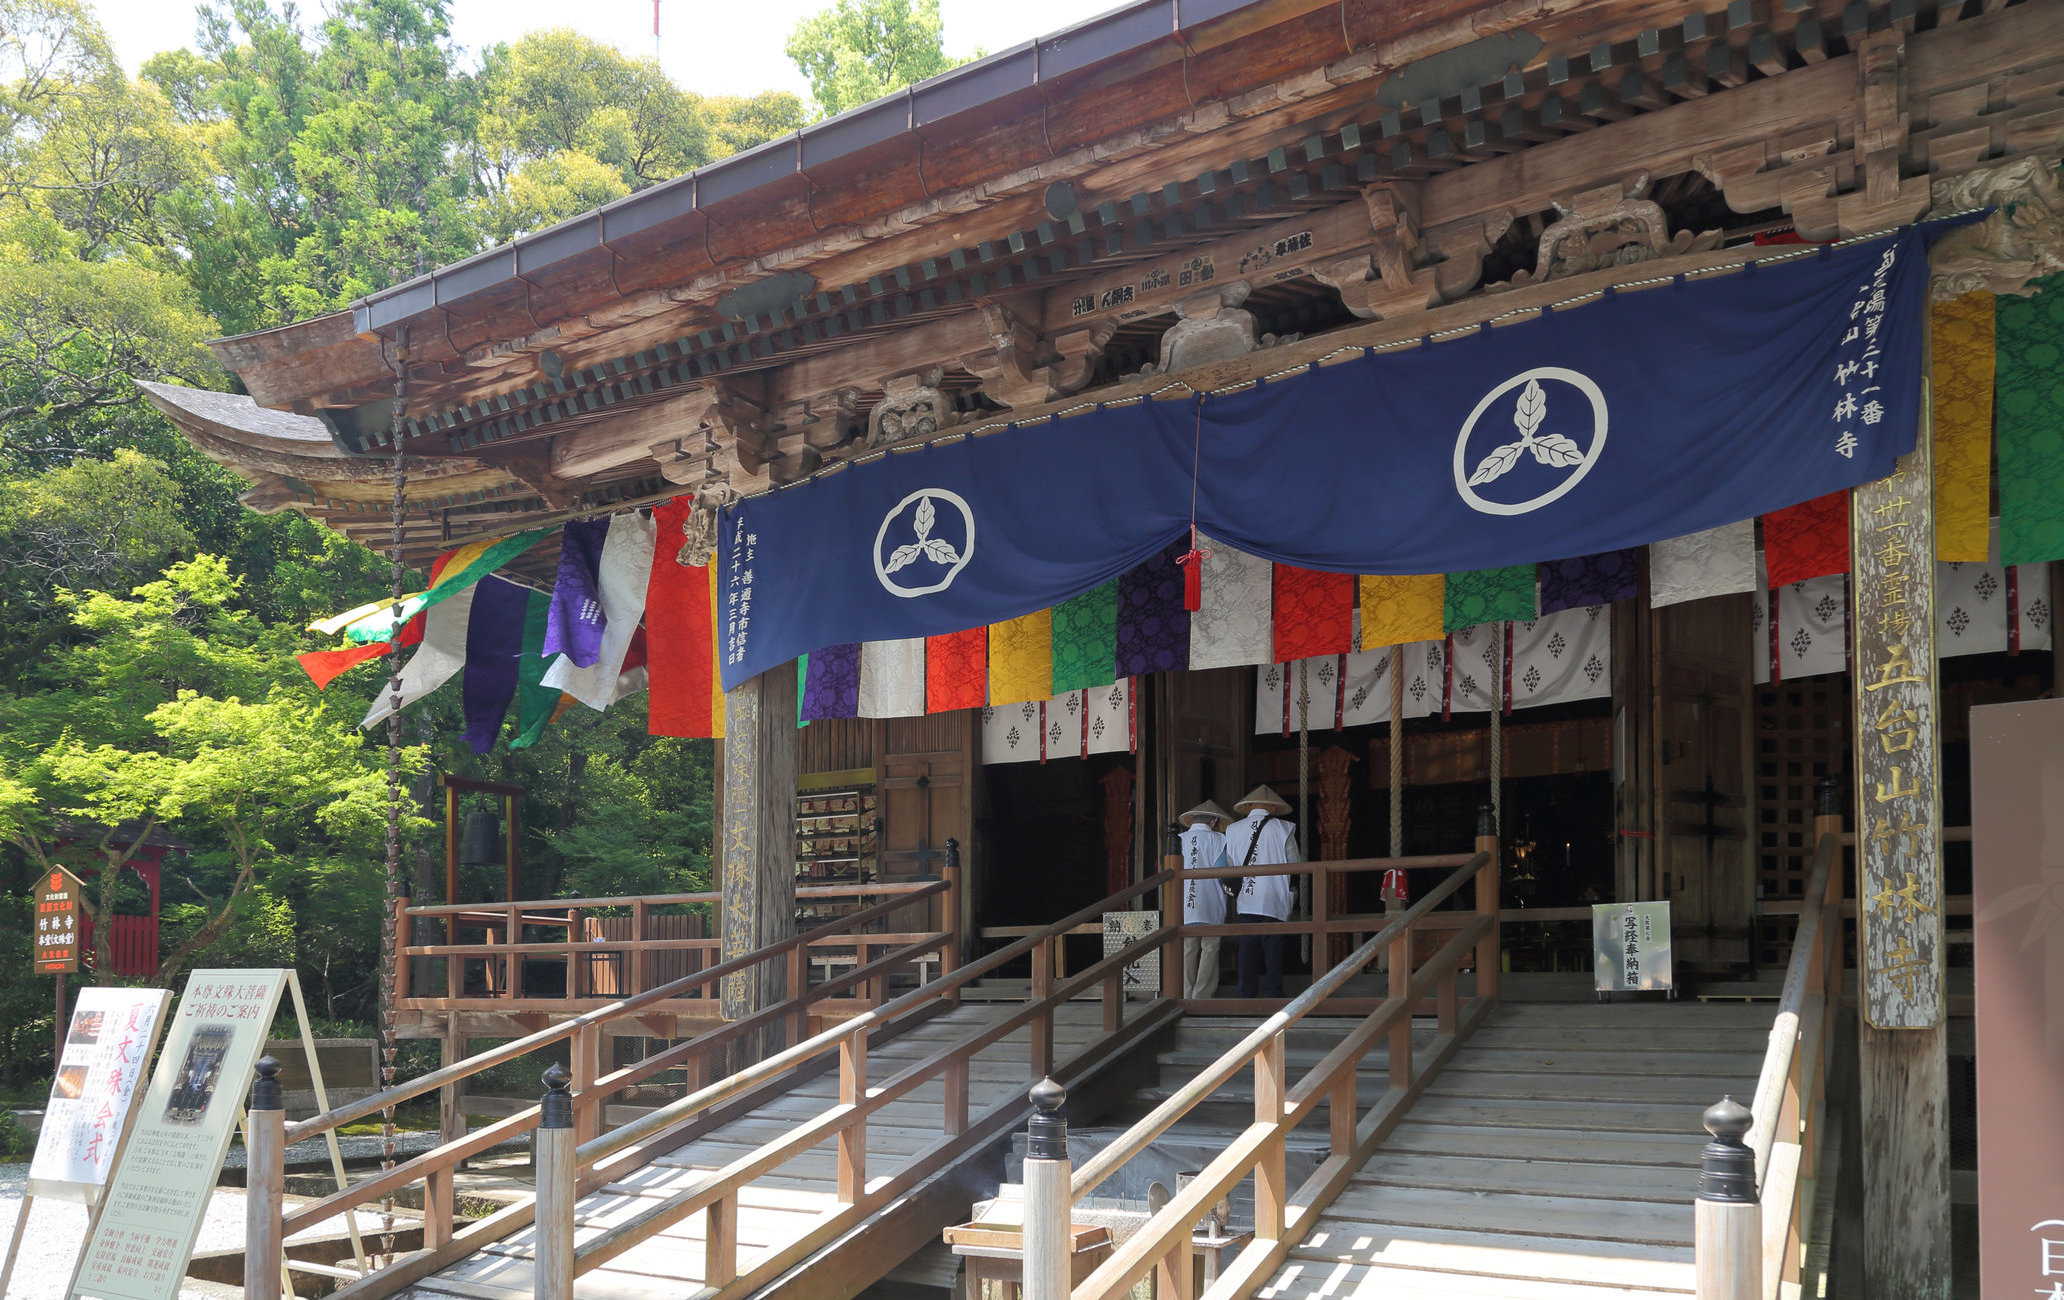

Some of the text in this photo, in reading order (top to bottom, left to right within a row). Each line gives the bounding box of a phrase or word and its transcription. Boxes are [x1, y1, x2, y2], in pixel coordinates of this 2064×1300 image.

[1833, 360, 1860, 459] 竹林寺
[728, 516, 744, 666] 平成二十六年三月吉日
[39, 914, 74, 931] 竹林寺
[1624, 916, 1640, 985] 写経奉納箱
[192, 984, 269, 1000] 本尊文殊大菩薩
[82, 1002, 144, 1166] 夏文殊会式
